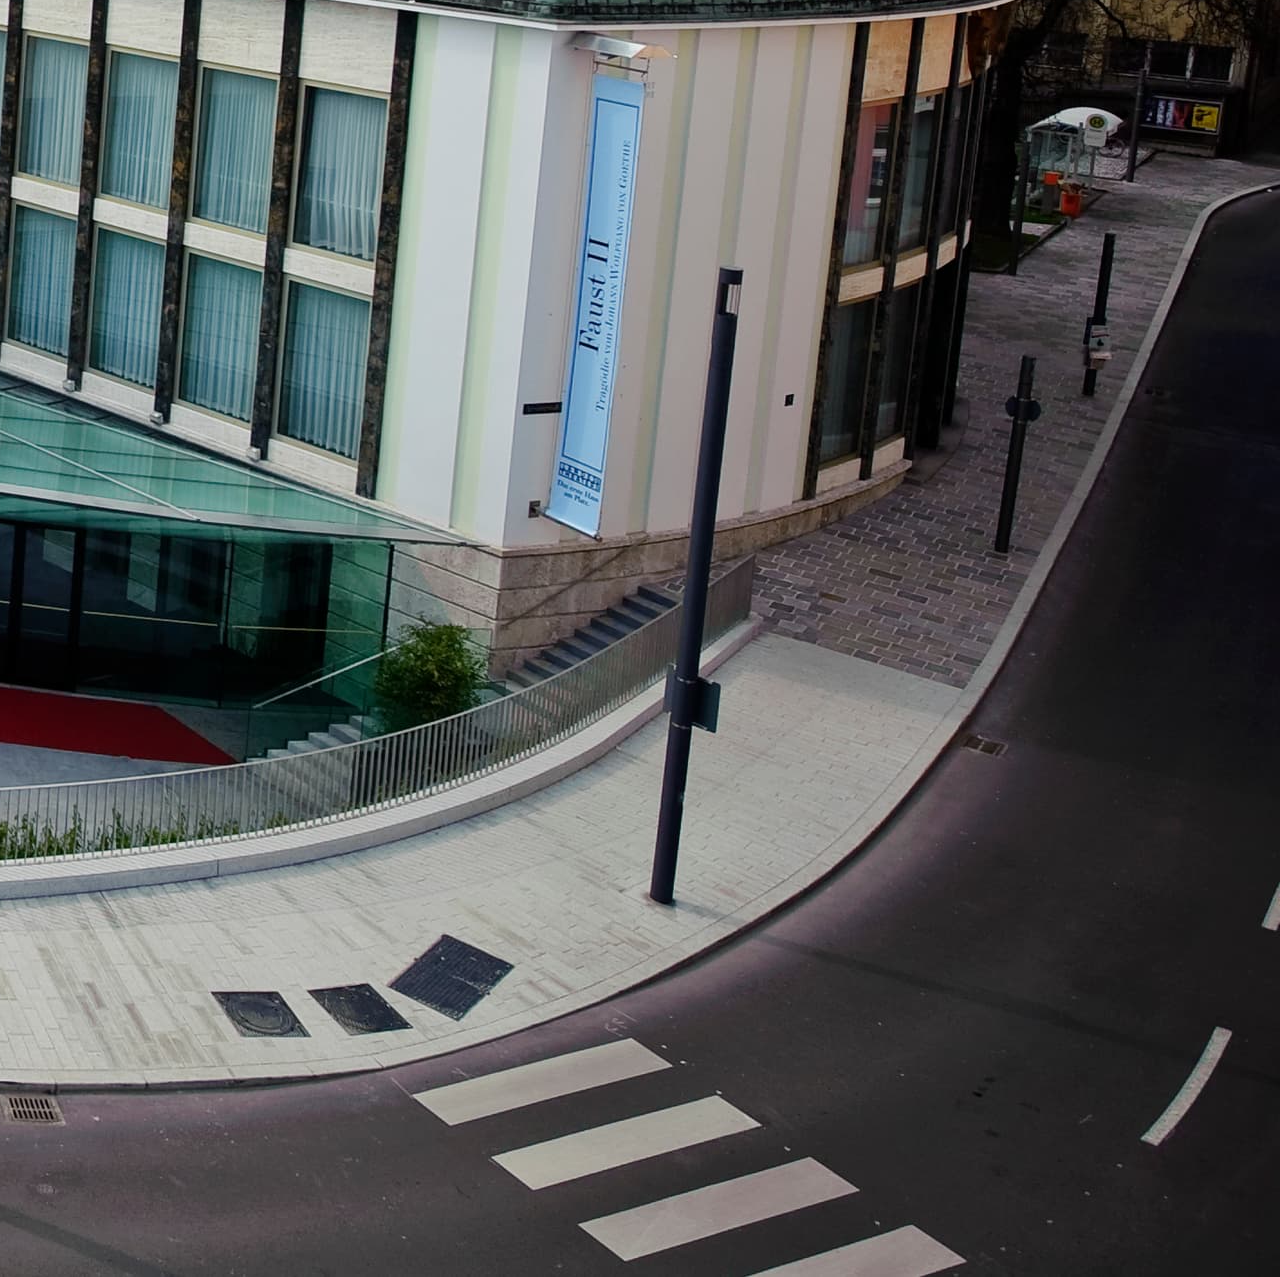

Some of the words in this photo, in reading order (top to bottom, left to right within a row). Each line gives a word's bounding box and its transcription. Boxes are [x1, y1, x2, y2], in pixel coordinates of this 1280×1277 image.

[587, 237, 609, 263] II
[578, 272, 607, 354] Faust
[594, 357, 611, 413] Tragödie
[603, 332, 614, 355] von
